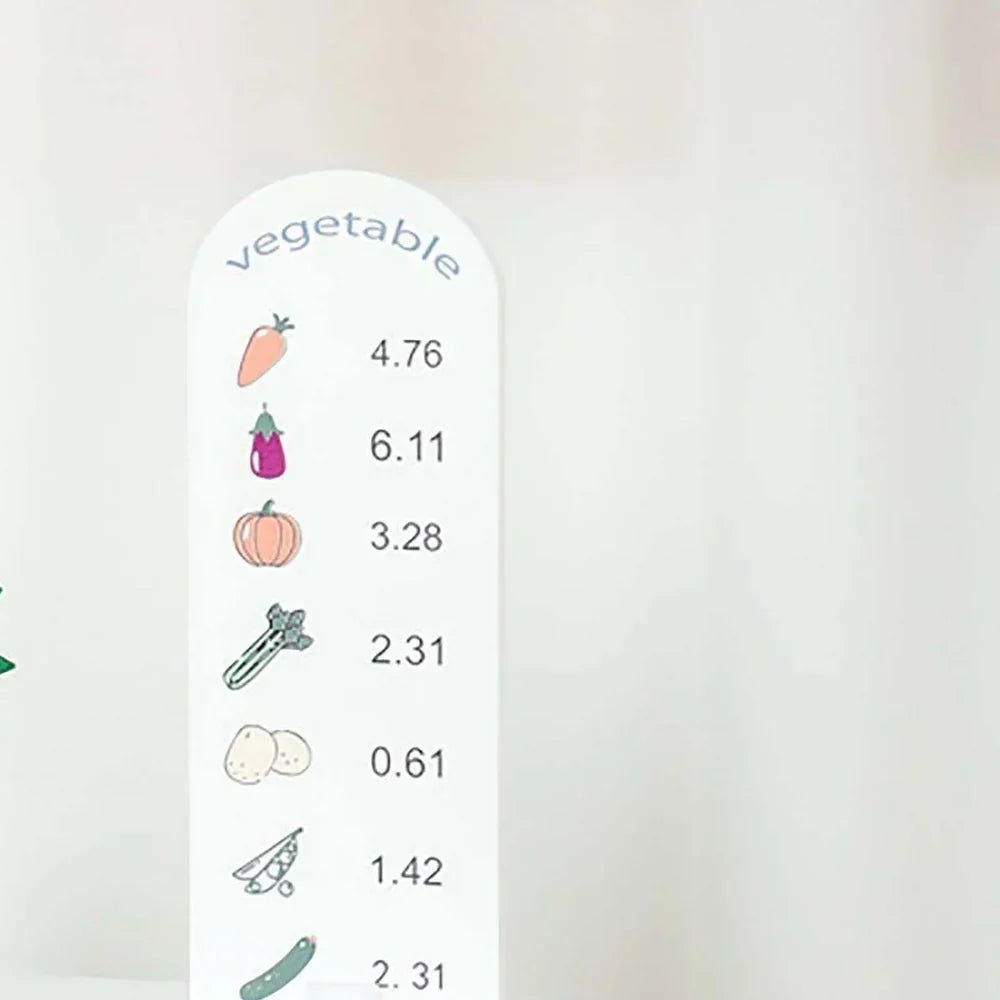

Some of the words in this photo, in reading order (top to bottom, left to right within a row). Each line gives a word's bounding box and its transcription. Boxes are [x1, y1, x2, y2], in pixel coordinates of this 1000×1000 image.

[226, 211, 461, 281] vegetable
[370, 339, 444, 369] 4.76
[370, 430, 445, 462] 6.11
[370, 521, 443, 552] 3.28
[370, 634, 445, 666] 2.31
[370, 746, 445, 778] 0.61
[371, 855, 444, 887] 1.42
